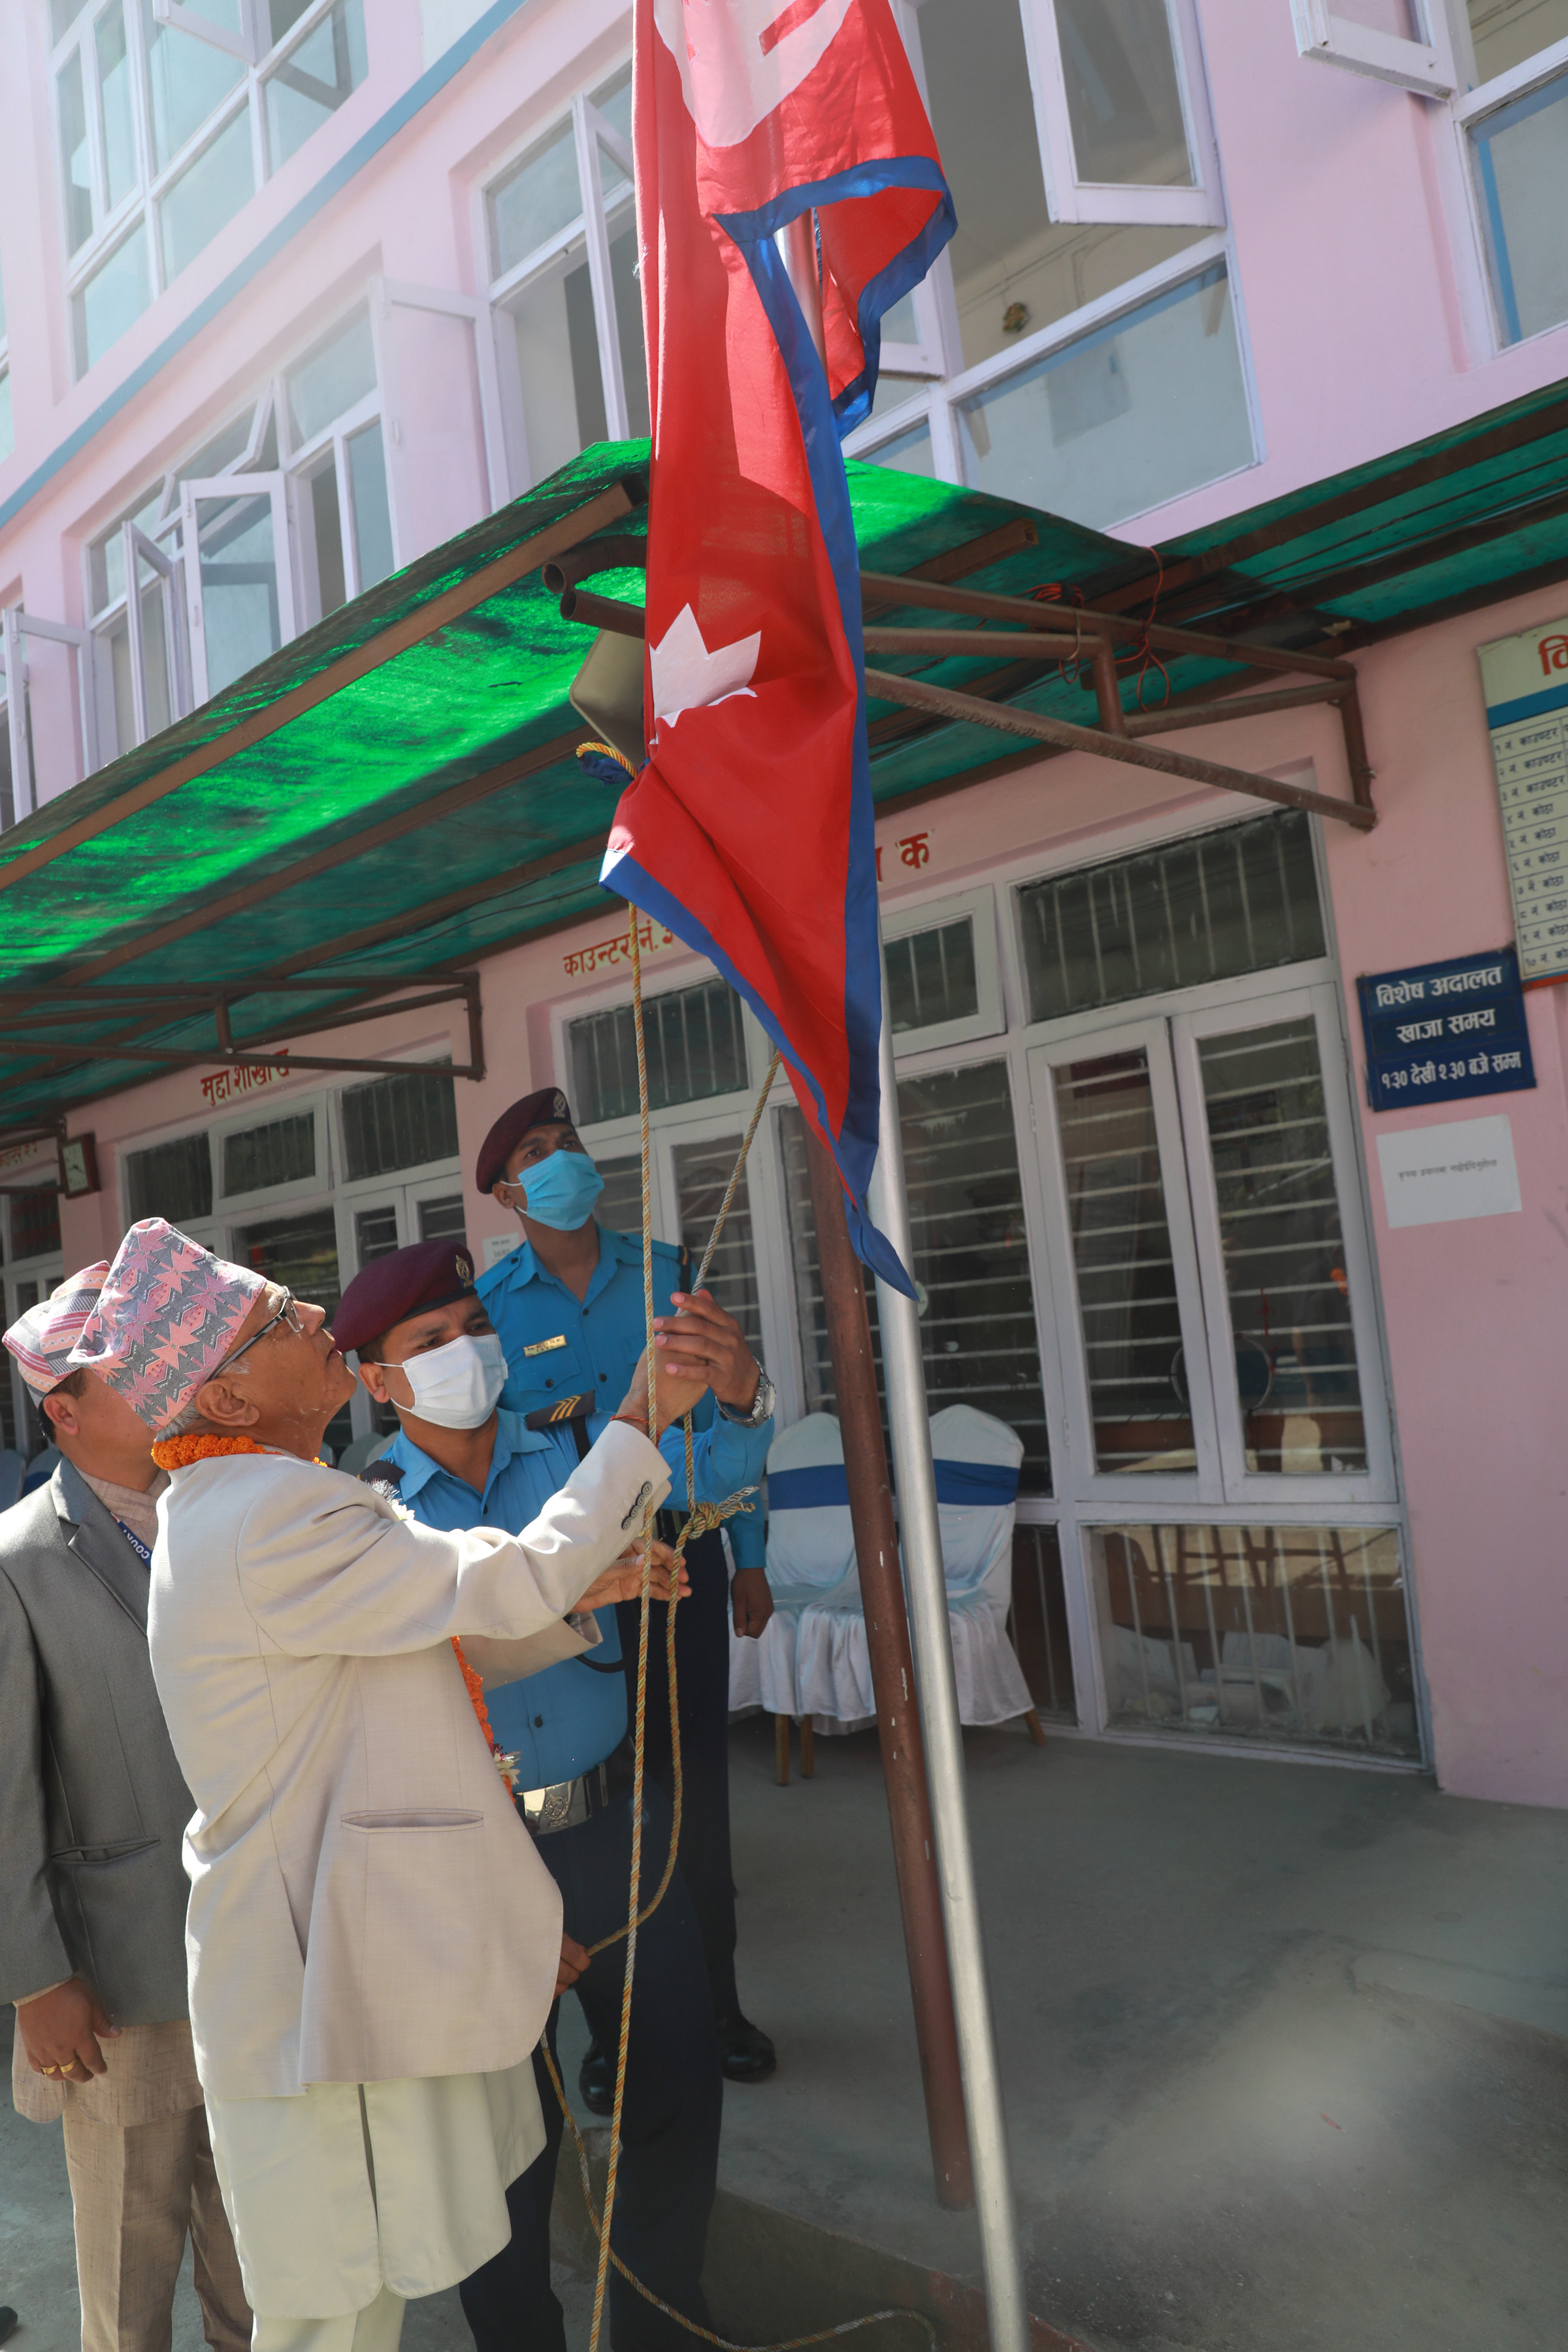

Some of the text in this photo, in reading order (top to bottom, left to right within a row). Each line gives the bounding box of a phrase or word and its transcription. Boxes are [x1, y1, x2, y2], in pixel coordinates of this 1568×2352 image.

[1376, 966, 1502, 1007] विशेष अदालत
[1396, 1008, 1496, 1043] खाजा समय
